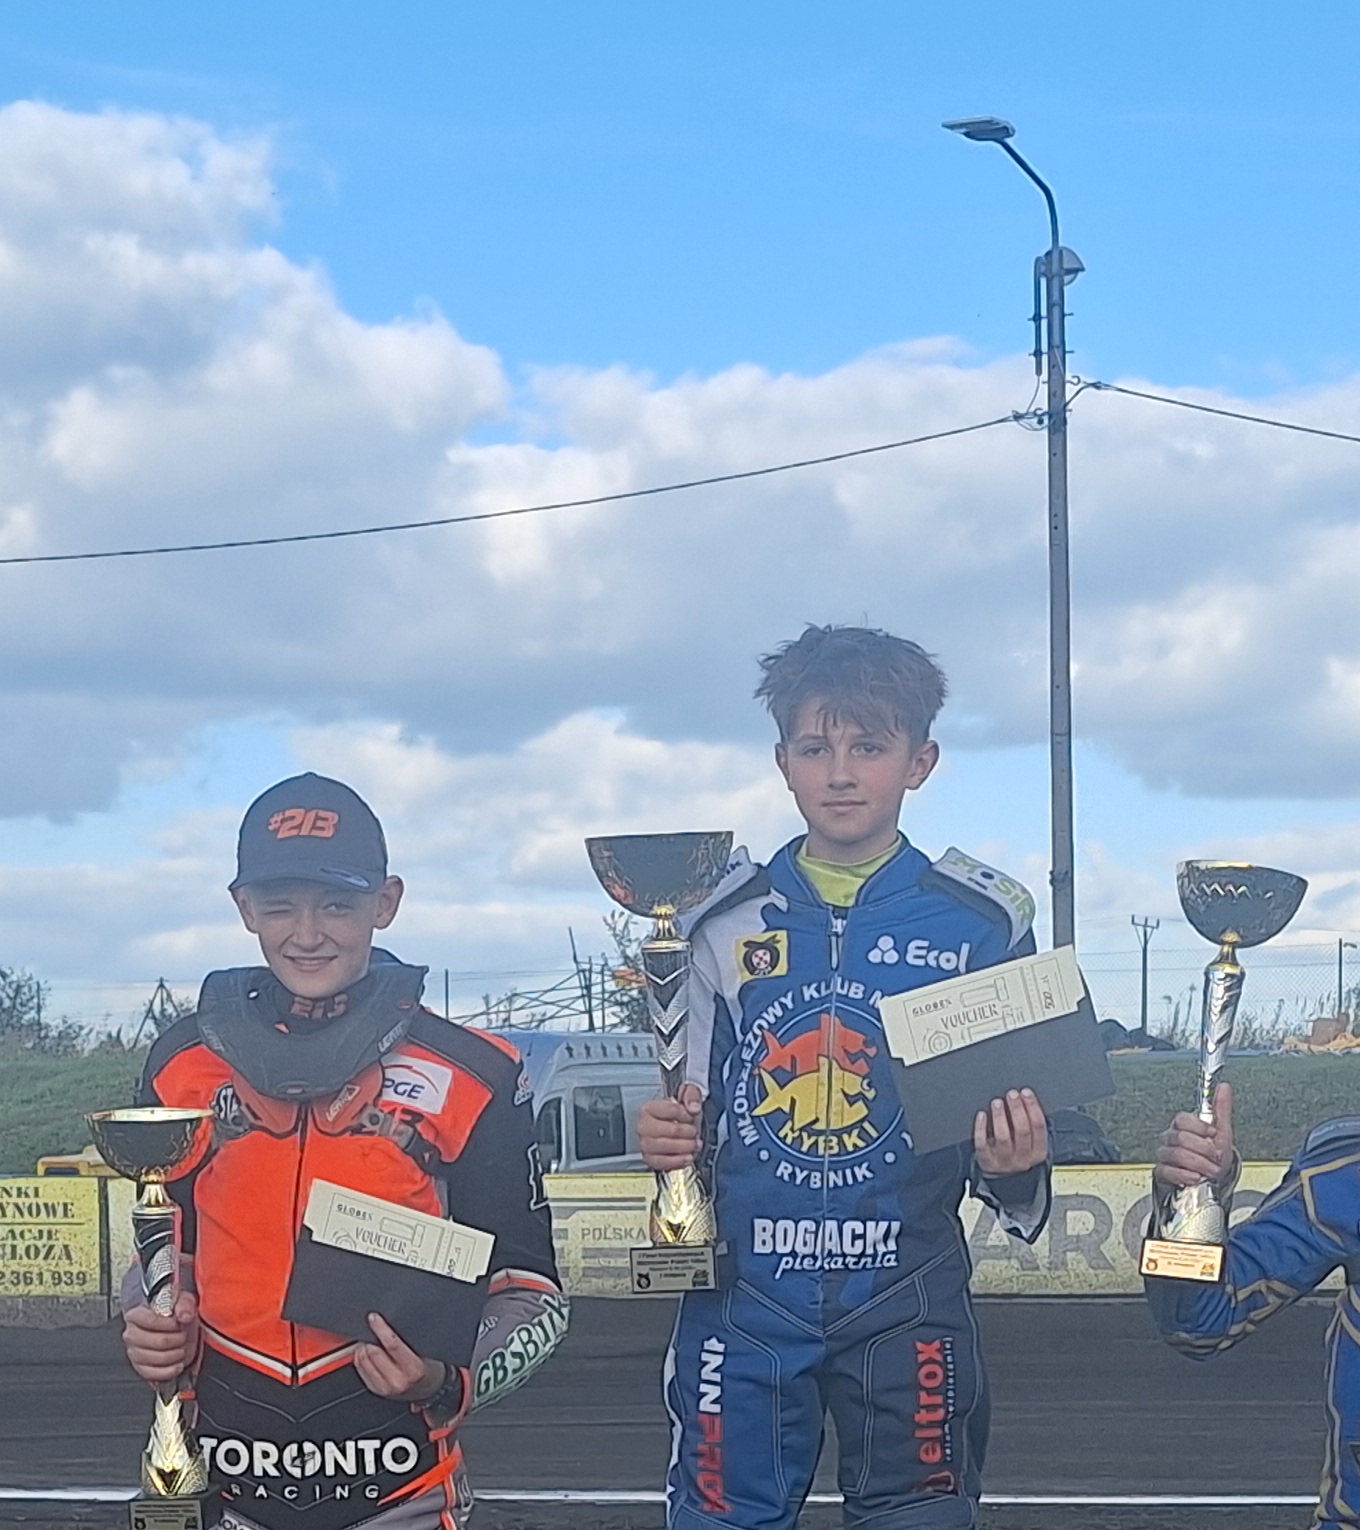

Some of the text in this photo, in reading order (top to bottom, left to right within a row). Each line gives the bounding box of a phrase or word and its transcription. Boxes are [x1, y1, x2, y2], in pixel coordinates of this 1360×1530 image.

[906, 940, 970, 974] Ecol
[801, 975, 867, 1002] KLUB
[940, 1003, 1005, 1031] VOUCHER
[776, 1160, 875, 1190] RYBNIK
[355, 1227, 408, 1256] VOUCHER
[581, 1226, 647, 1242] POLSKA
[752, 1218, 902, 1256] BOGACKI
[10, 1270, 45, 1287] 361
[50, 1269, 88, 1287] 939
[774, 1250, 899, 1281] piekarnia
[913, 1339, 945, 1465] eltrox
[199, 1436, 420, 1478] TORONTO
[230, 1483, 380, 1500] RACING
